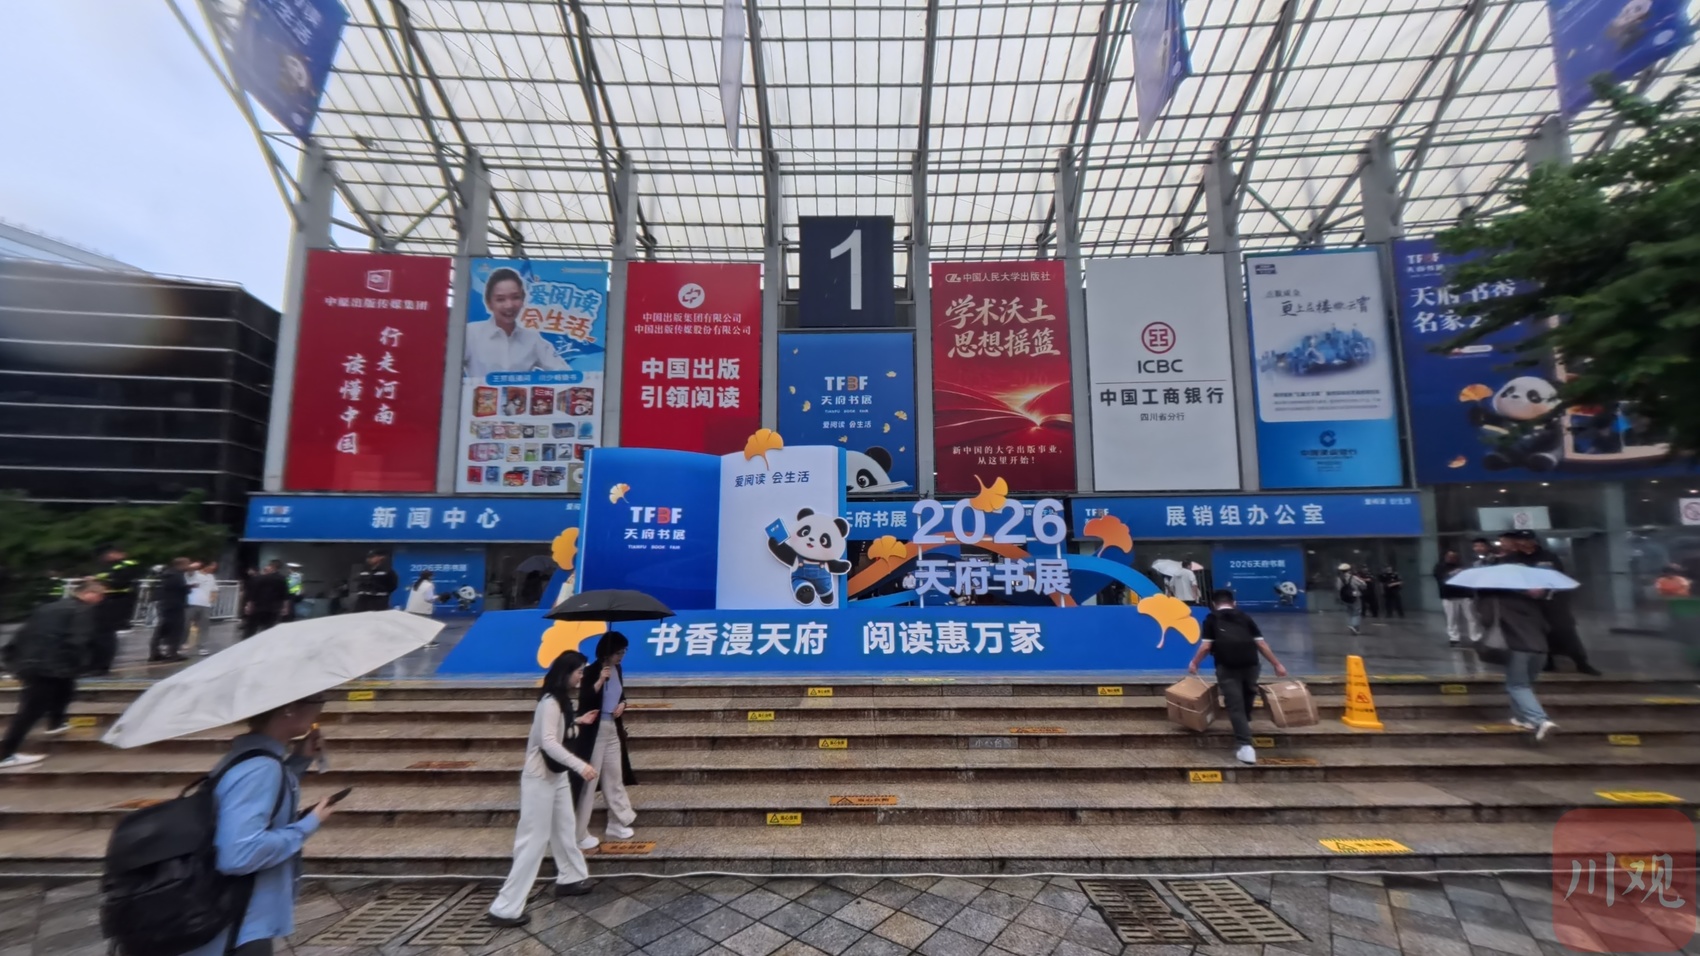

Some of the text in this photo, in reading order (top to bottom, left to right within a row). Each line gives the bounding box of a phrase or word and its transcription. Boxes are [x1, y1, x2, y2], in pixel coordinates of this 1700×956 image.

[830, 229, 861, 310] 1
[963, 271, 1051, 282] 中国人民大学出版社
[528, 284, 599, 318] 爱阅读
[942, 294, 1056, 329] 学术沃土
[521, 308, 592, 340] 会生活
[643, 312, 742, 323] 中国出版集团有限公司
[635, 324, 751, 335] 中国出版传媒股份有限公司
[947, 327, 1061, 358] 思想摇篮
[374, 326, 403, 425] 行走河南
[641, 357, 740, 380] 中国出版
[1137, 359, 1184, 374] ICBC
[824, 376, 868, 391] TFBF
[336, 353, 367, 455] 读懂中国
[641, 385, 740, 408] 引领阅读
[821, 395, 872, 405] 天府书展
[1100, 387, 1224, 406] 中国工商银行
[849, 420, 872, 428] 会生活
[1140, 412, 1185, 421] 四川省分行
[977, 456, 1035, 465] 从这里开始！
[734, 470, 810, 488] 爱阅读 会生活
[372, 506, 500, 529] 新闻中心
[630, 506, 682, 524] TFBF
[912, 498, 1067, 545] 2026
[1166, 504, 1325, 527] 展销组办公室
[624, 528, 686, 540] 天府书展
[915, 558, 1071, 596] 天府书展
[647, 621, 1045, 656] 书香漫天府 阅读惠万家
